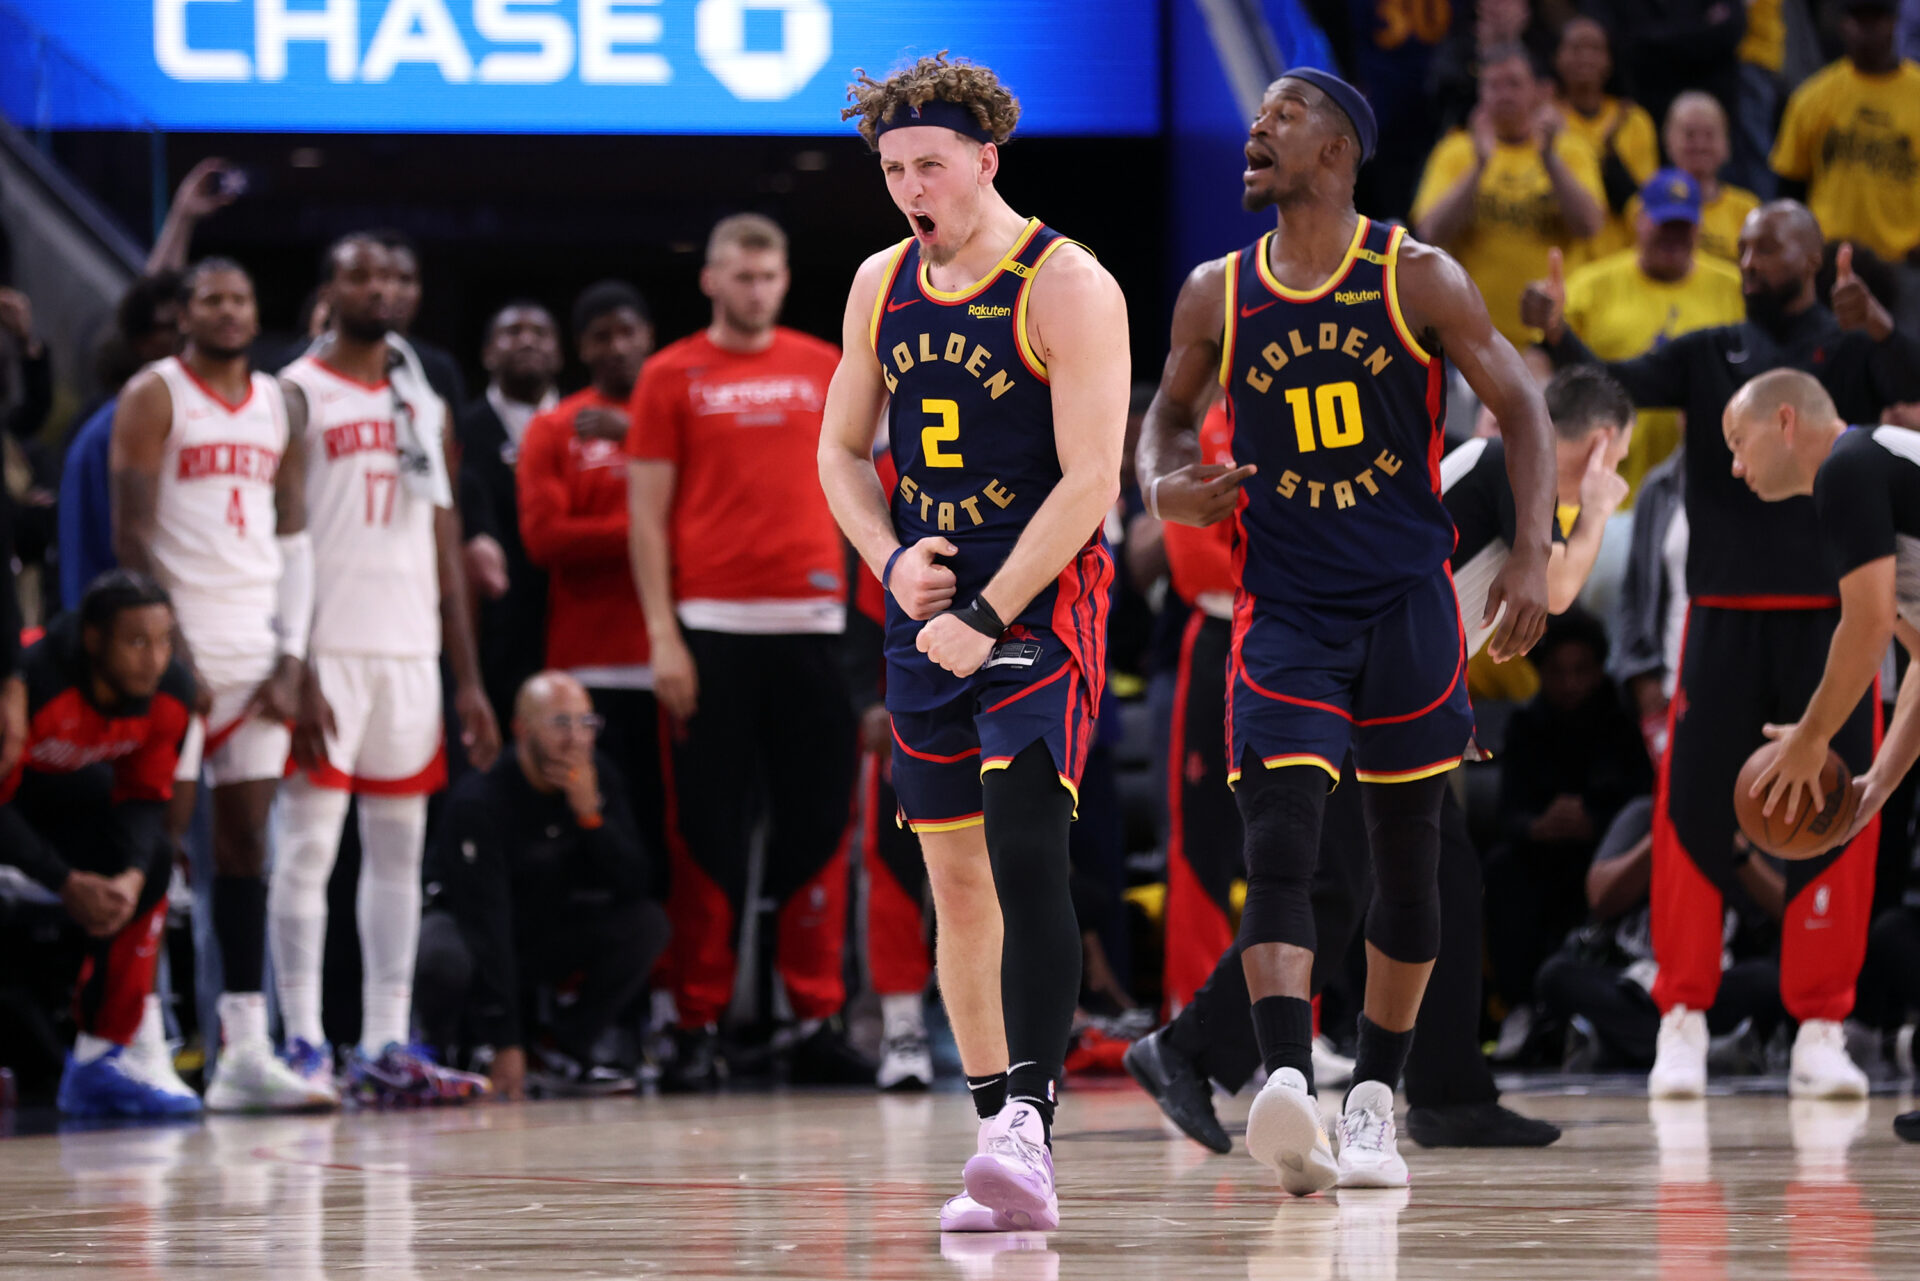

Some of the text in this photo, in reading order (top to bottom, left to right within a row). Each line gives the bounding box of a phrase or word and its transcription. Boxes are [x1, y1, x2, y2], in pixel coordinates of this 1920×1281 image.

[153, 0, 672, 85] CHASE
[1013, 264, 1026, 276] 16
[1334, 289, 1381, 304] Rakuten
[968, 304, 1011, 318] Rakuten
[883, 332, 1016, 401] GOLDEN
[1246, 322, 1393, 394] GOLDEN
[921, 398, 964, 468] 2
[1284, 380, 1364, 453] 10
[365, 471, 398, 526] 17
[900, 475, 1016, 531] STATE
[1275, 448, 1403, 510] STATE
[226, 486, 246, 539] 4
[1010, 1110, 1029, 1129] 2
